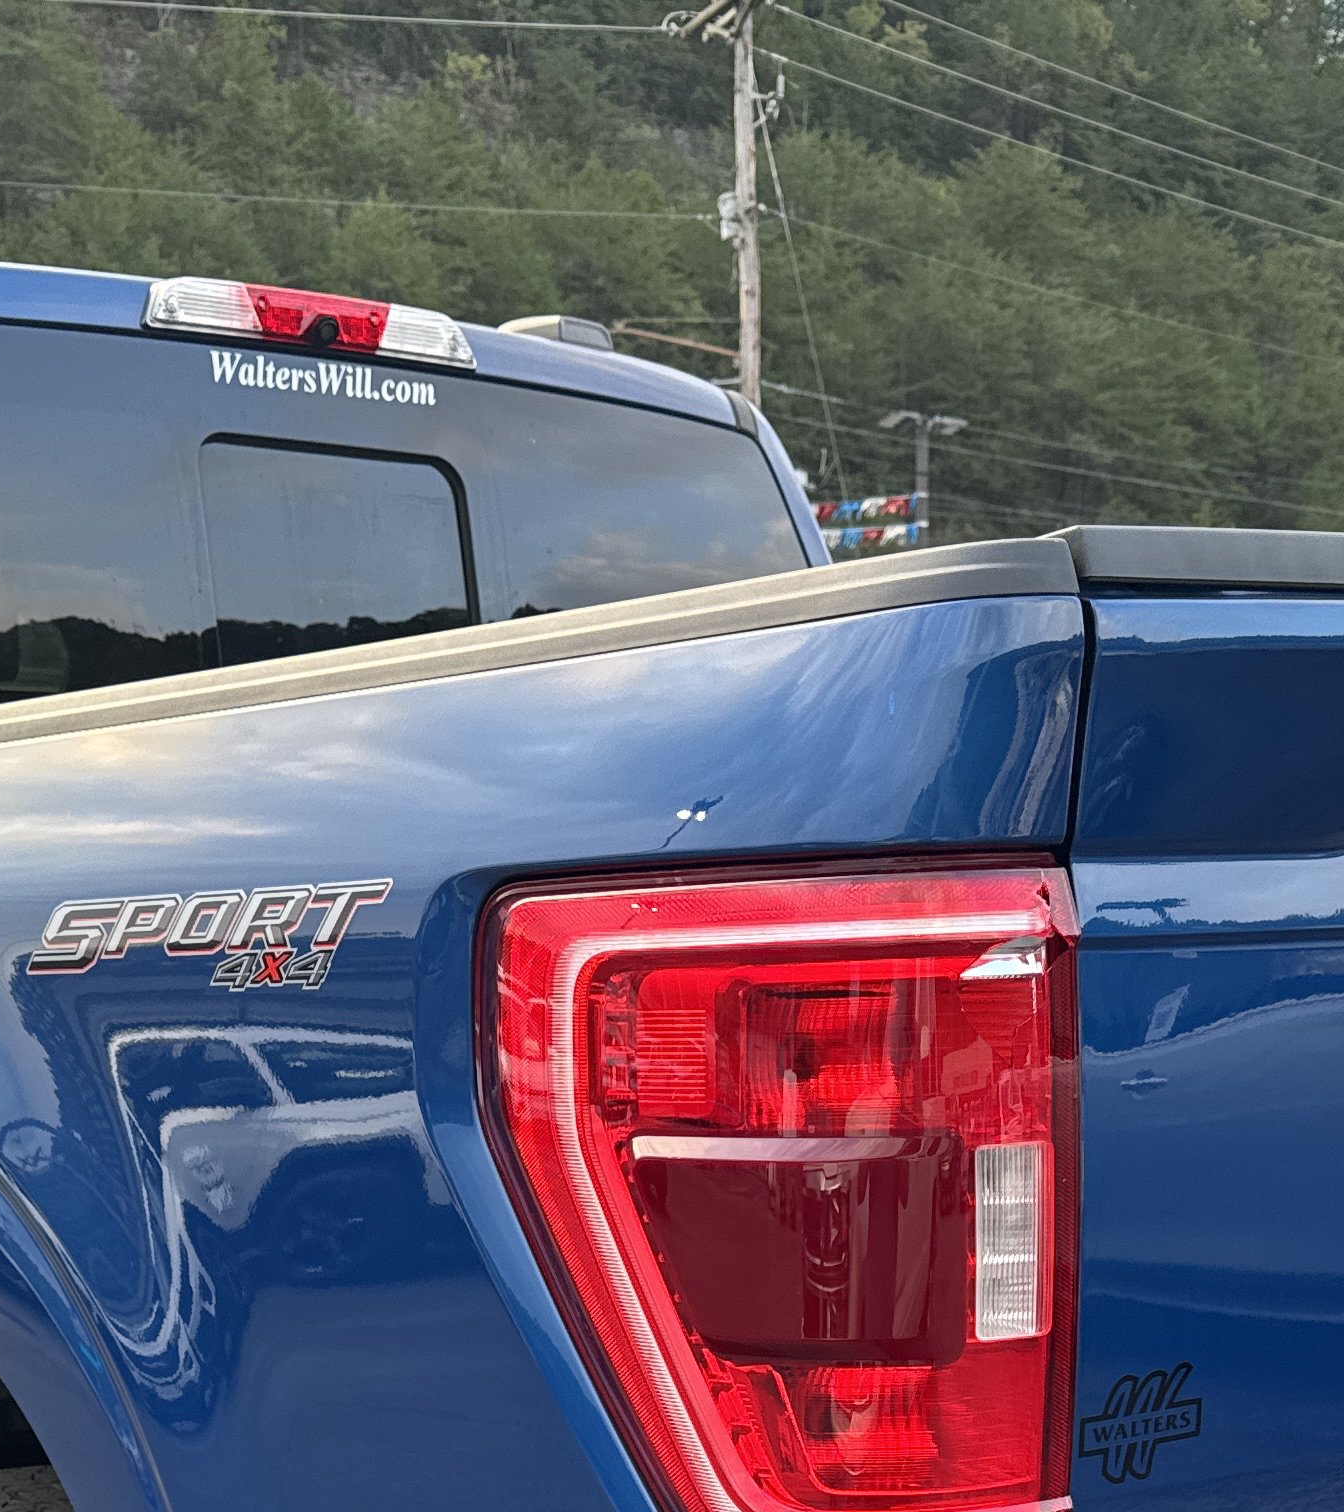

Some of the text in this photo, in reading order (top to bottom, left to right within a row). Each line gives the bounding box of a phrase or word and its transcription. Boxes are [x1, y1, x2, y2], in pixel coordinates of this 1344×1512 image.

[209, 350, 437, 406] WaltersWill.com
[26, 878, 394, 976] SPORT
[1092, 1411, 1193, 1443] WALTERS
